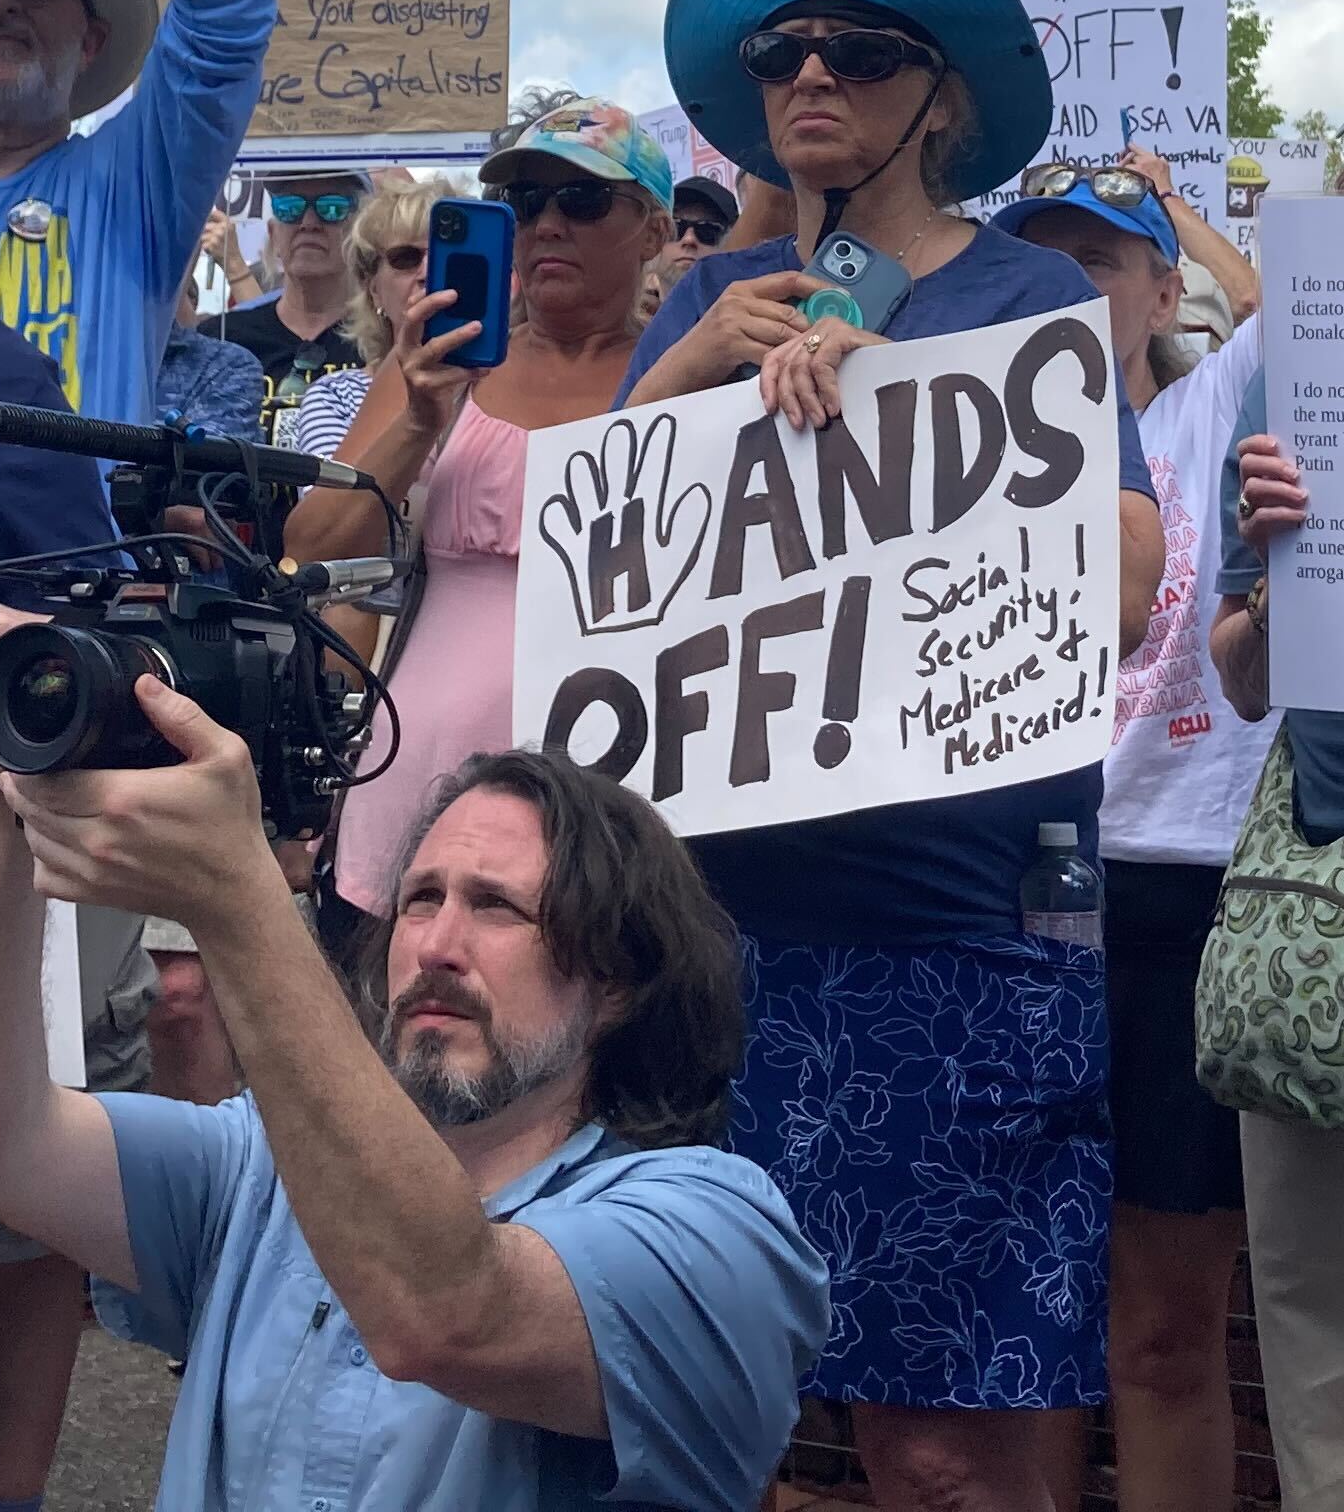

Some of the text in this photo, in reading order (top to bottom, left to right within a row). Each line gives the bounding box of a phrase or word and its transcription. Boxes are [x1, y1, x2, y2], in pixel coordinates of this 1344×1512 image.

[315, 43, 502, 111] Capitalists
[1185, 105, 1222, 136] VA
[1228, 139, 1317, 159] YOU CAN
[1302, 275, 1322, 292] do
[1303, 381, 1324, 399] do
[1293, 407, 1317, 424] the
[1294, 433, 1339, 453] tyrant
[588, 317, 1107, 624] HANDS
[1295, 455, 1334, 473] Putin
[1306, 516, 1325, 532] do
[1296, 541, 1314, 555] an
[542, 577, 872, 802] OFF!
[899, 654, 1044, 749] Medicare
[944, 647, 1107, 774] Medicaid!
[1168, 712, 1212, 739] ACLU
